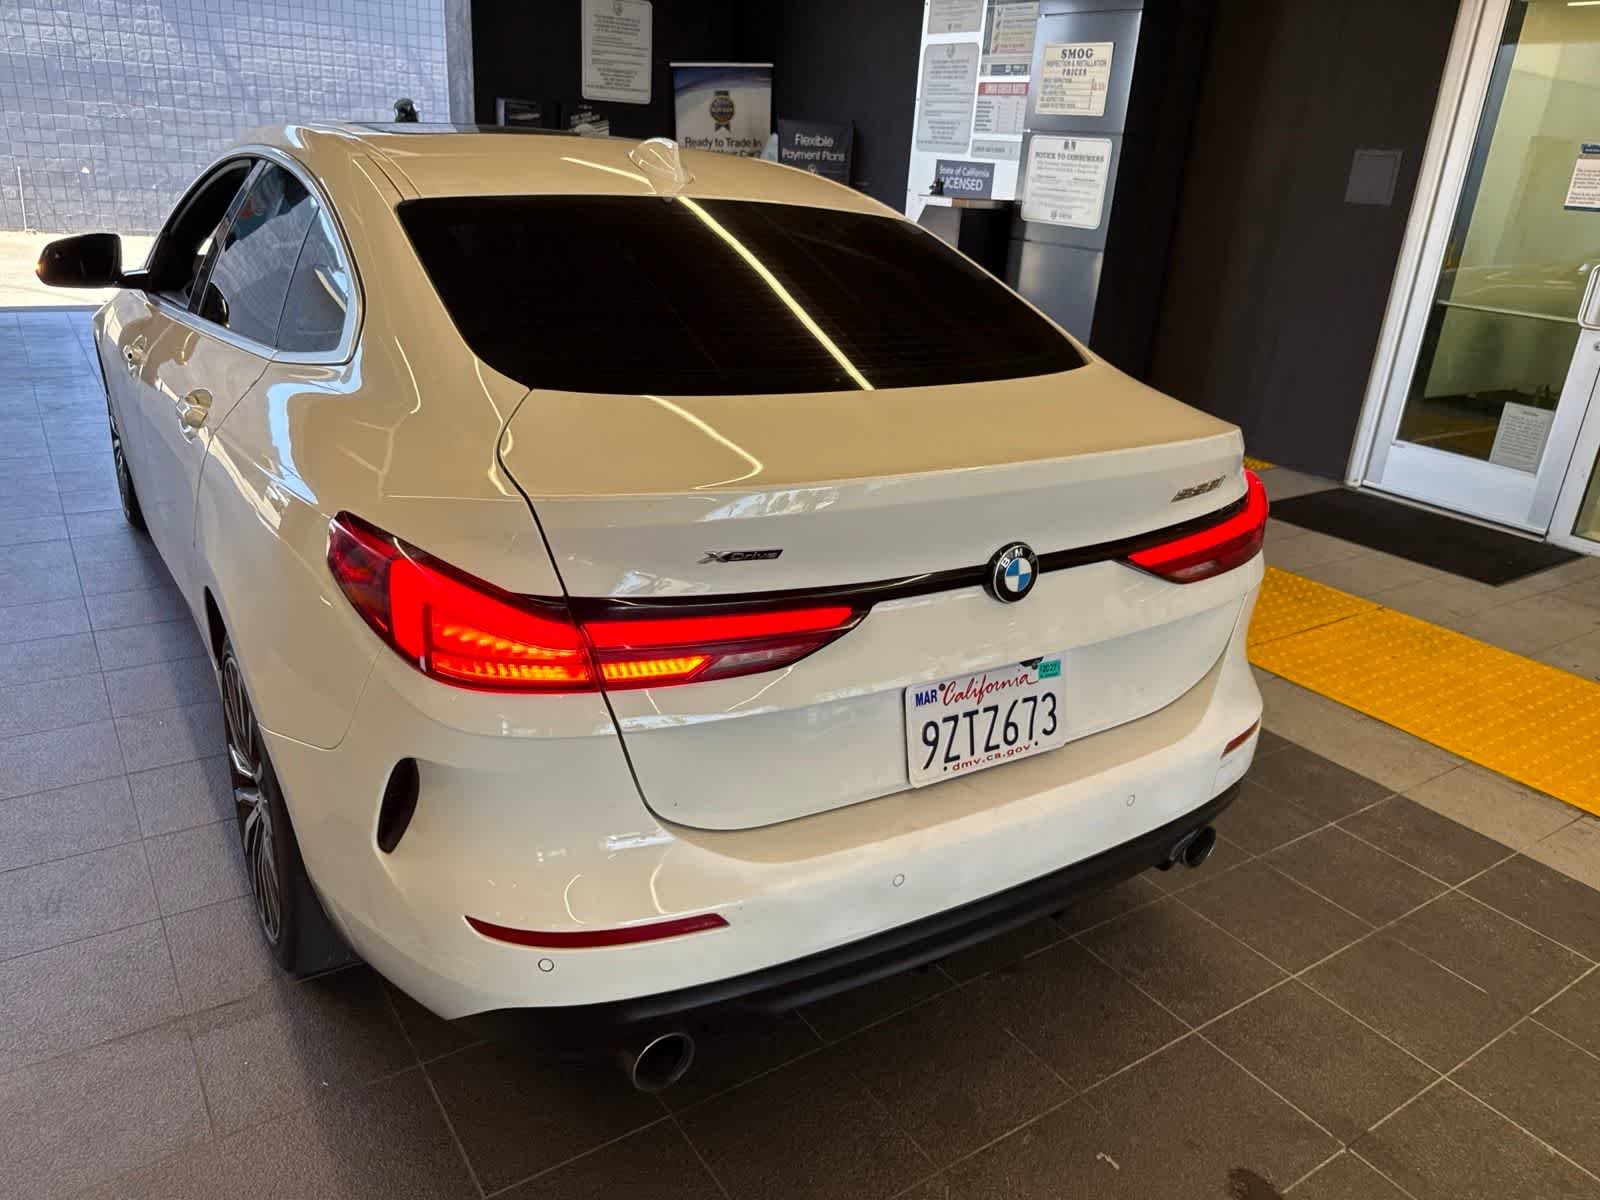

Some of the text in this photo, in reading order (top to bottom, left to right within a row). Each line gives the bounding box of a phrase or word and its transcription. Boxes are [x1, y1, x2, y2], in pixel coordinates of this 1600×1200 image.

[1061, 48, 1094, 60] SMOG
[1062, 68, 1088, 76] PRICES
[684, 136, 713, 150] Ready
[714, 137, 725, 148] to
[795, 133, 834, 148] Flexible
[782, 148, 845, 162] Payment Plans
[962, 167, 990, 178] California
[915, 674, 1039, 707] MAR California
[922, 692, 1057, 770] 9ZTZ673
[952, 743, 1031, 772] dmv.ca.gov
